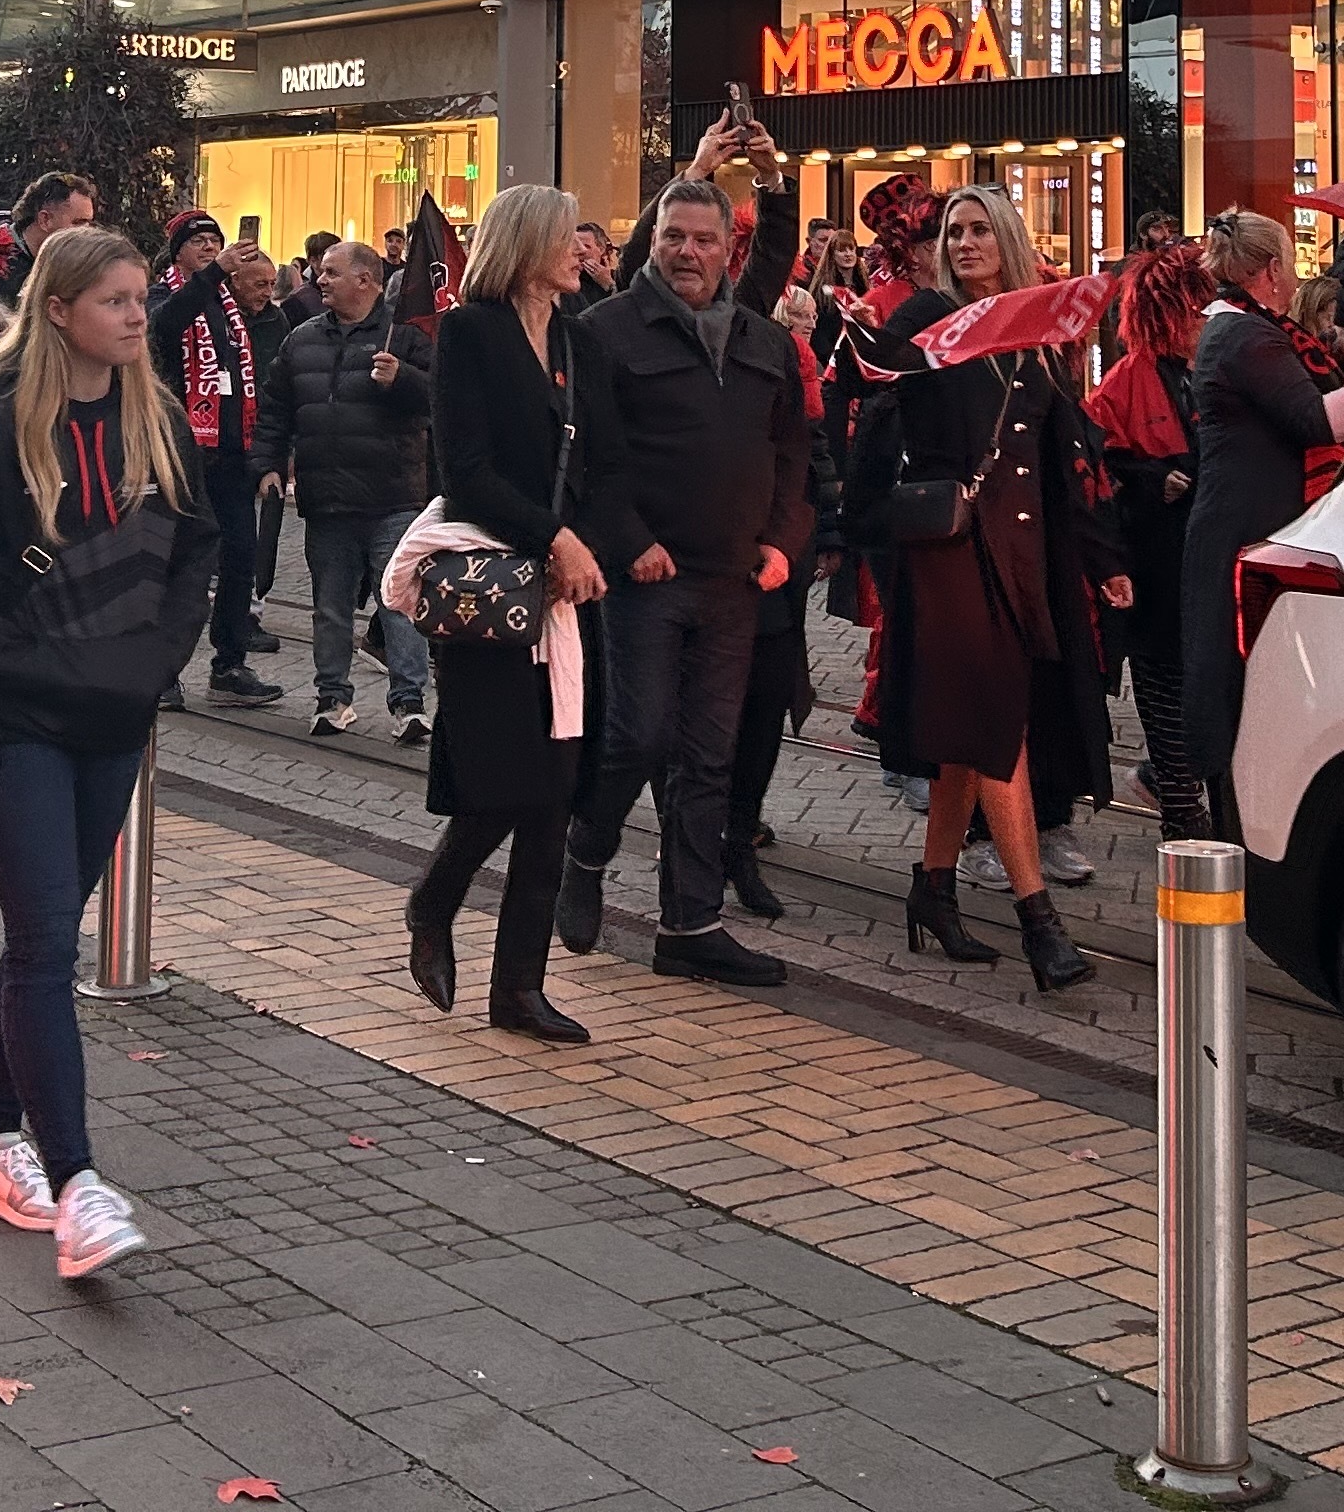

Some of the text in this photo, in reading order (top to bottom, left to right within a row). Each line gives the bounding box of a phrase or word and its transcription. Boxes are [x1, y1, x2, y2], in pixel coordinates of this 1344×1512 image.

[117, 34, 236, 62] ARTRIDGE
[761, 3, 1010, 96] MECCA
[281, 59, 366, 93] PARTRIDGE
